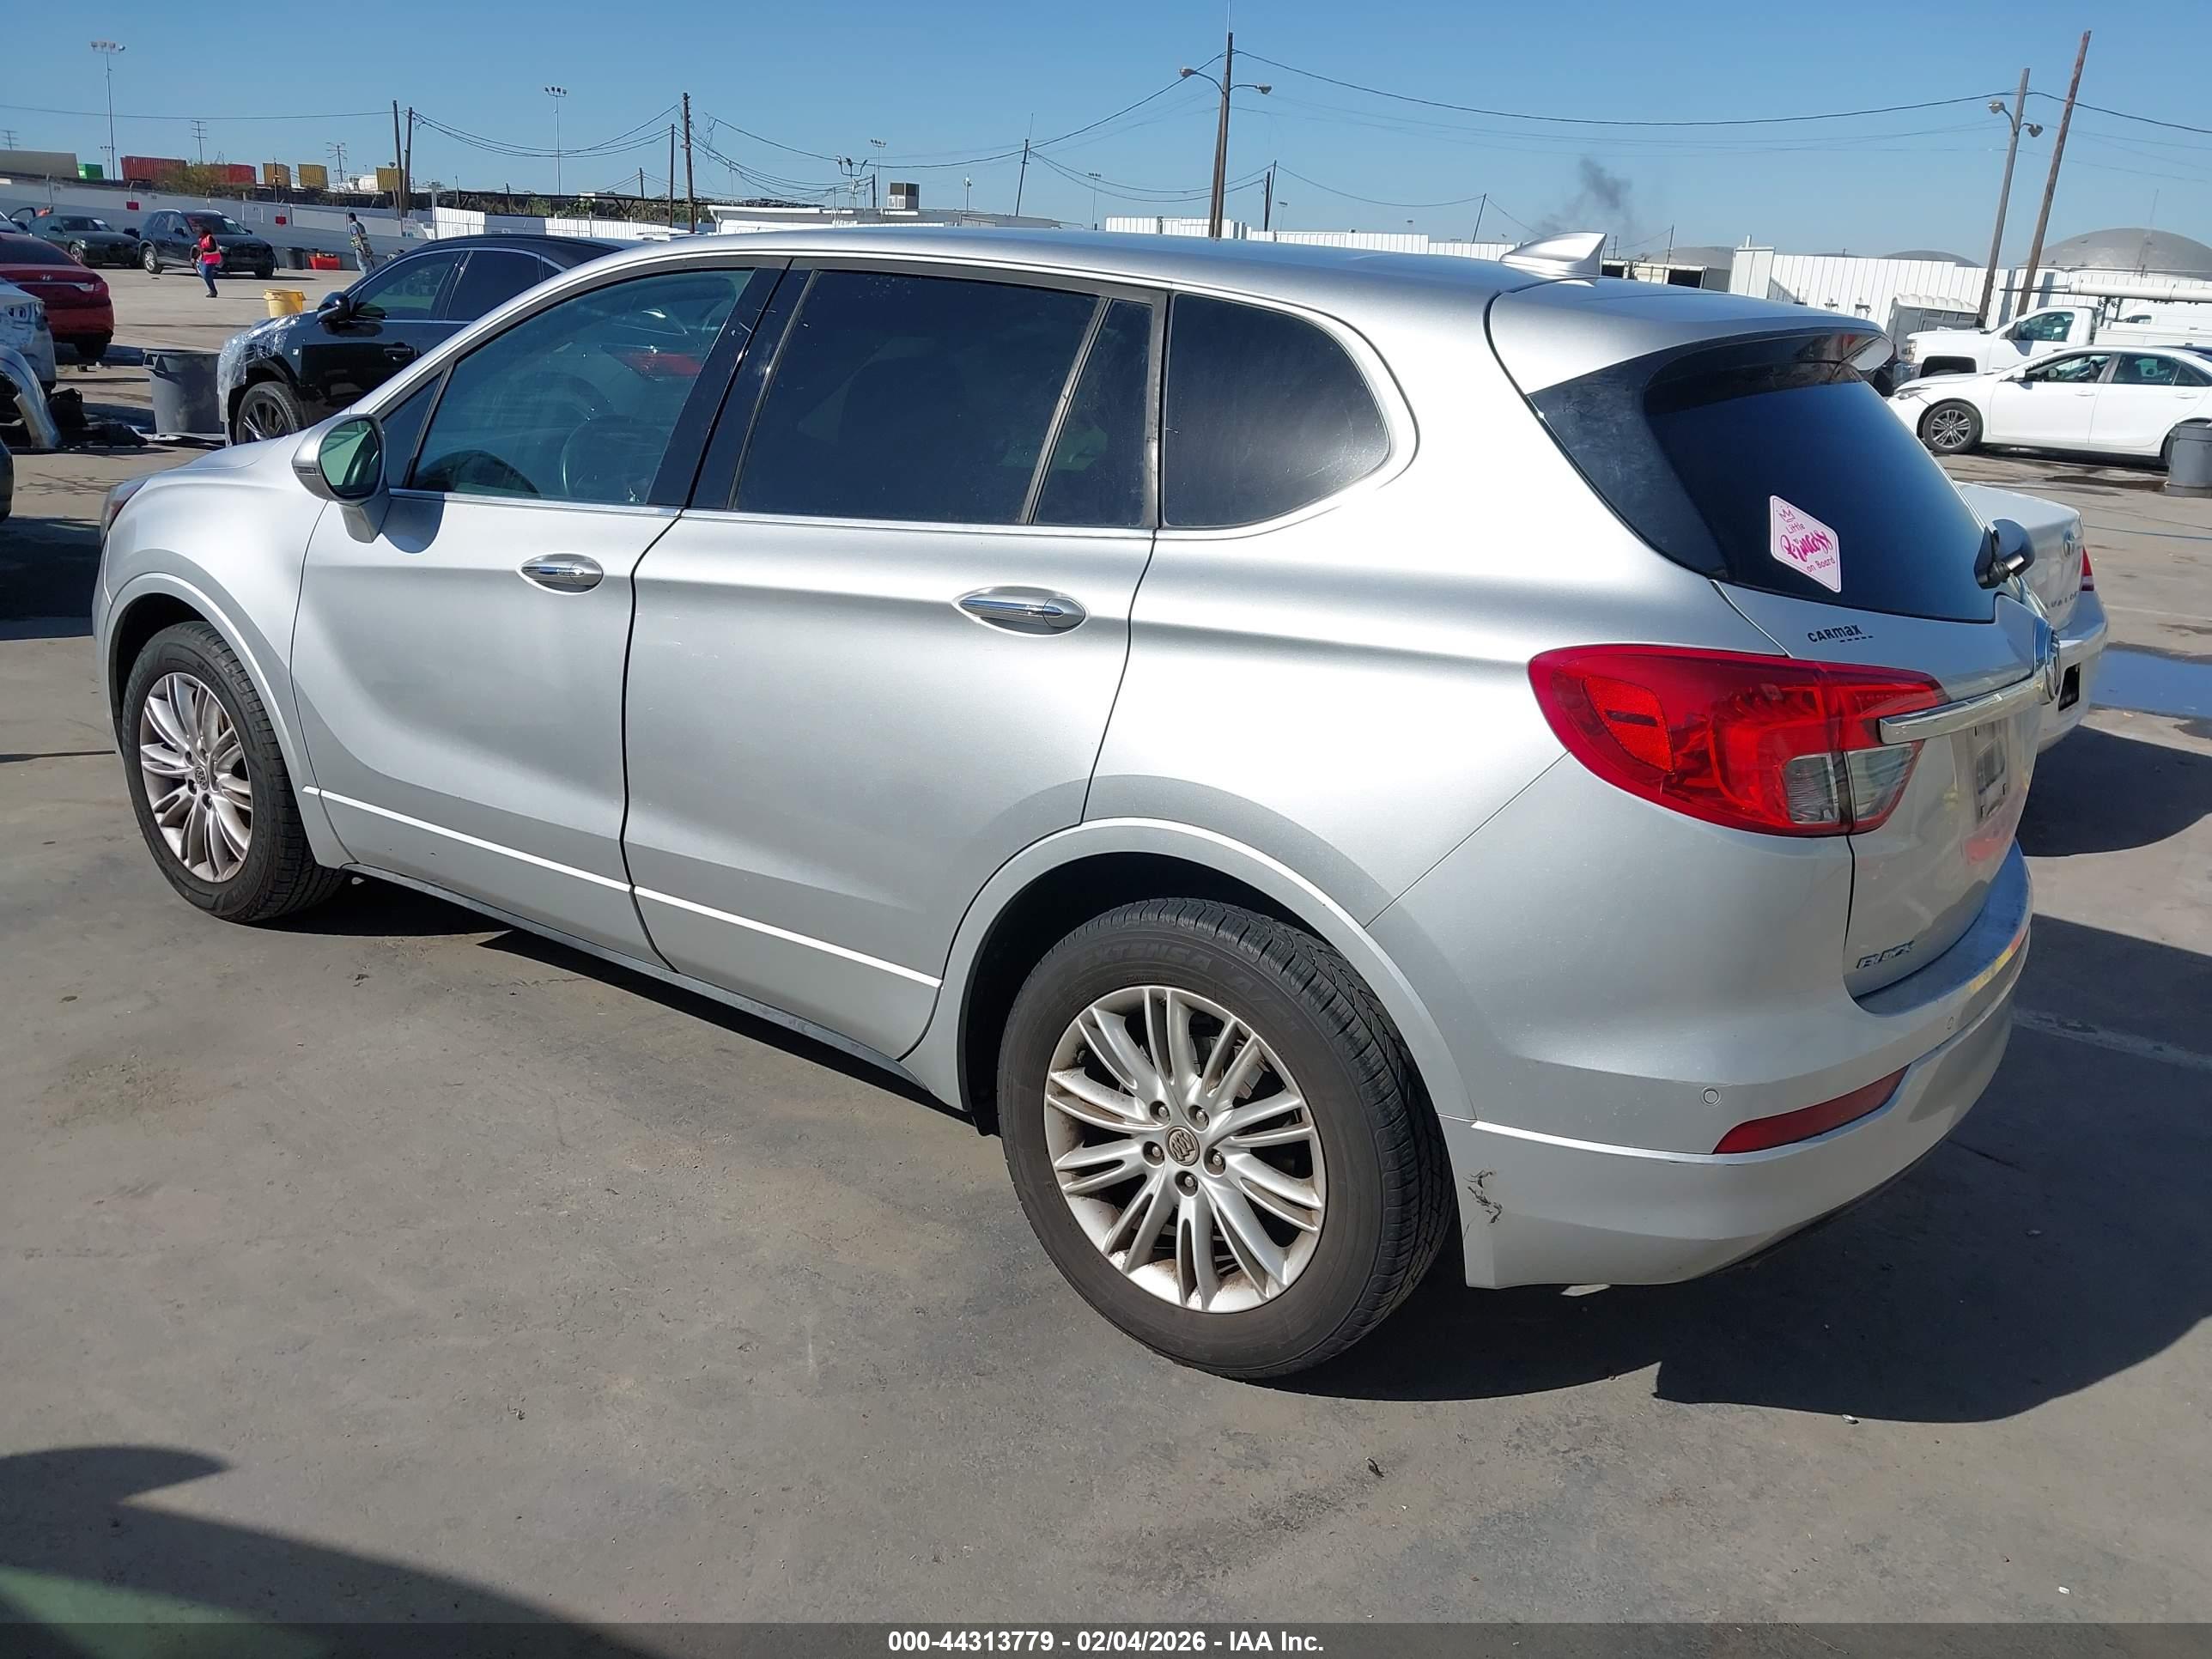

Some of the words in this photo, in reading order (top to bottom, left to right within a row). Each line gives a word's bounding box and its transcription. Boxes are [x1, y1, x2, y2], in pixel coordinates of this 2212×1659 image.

[1785, 522, 1806, 535] Little
[1780, 529, 1834, 563] Princess
[1806, 565, 1816, 574] on
[1815, 556, 1837, 569] Board
